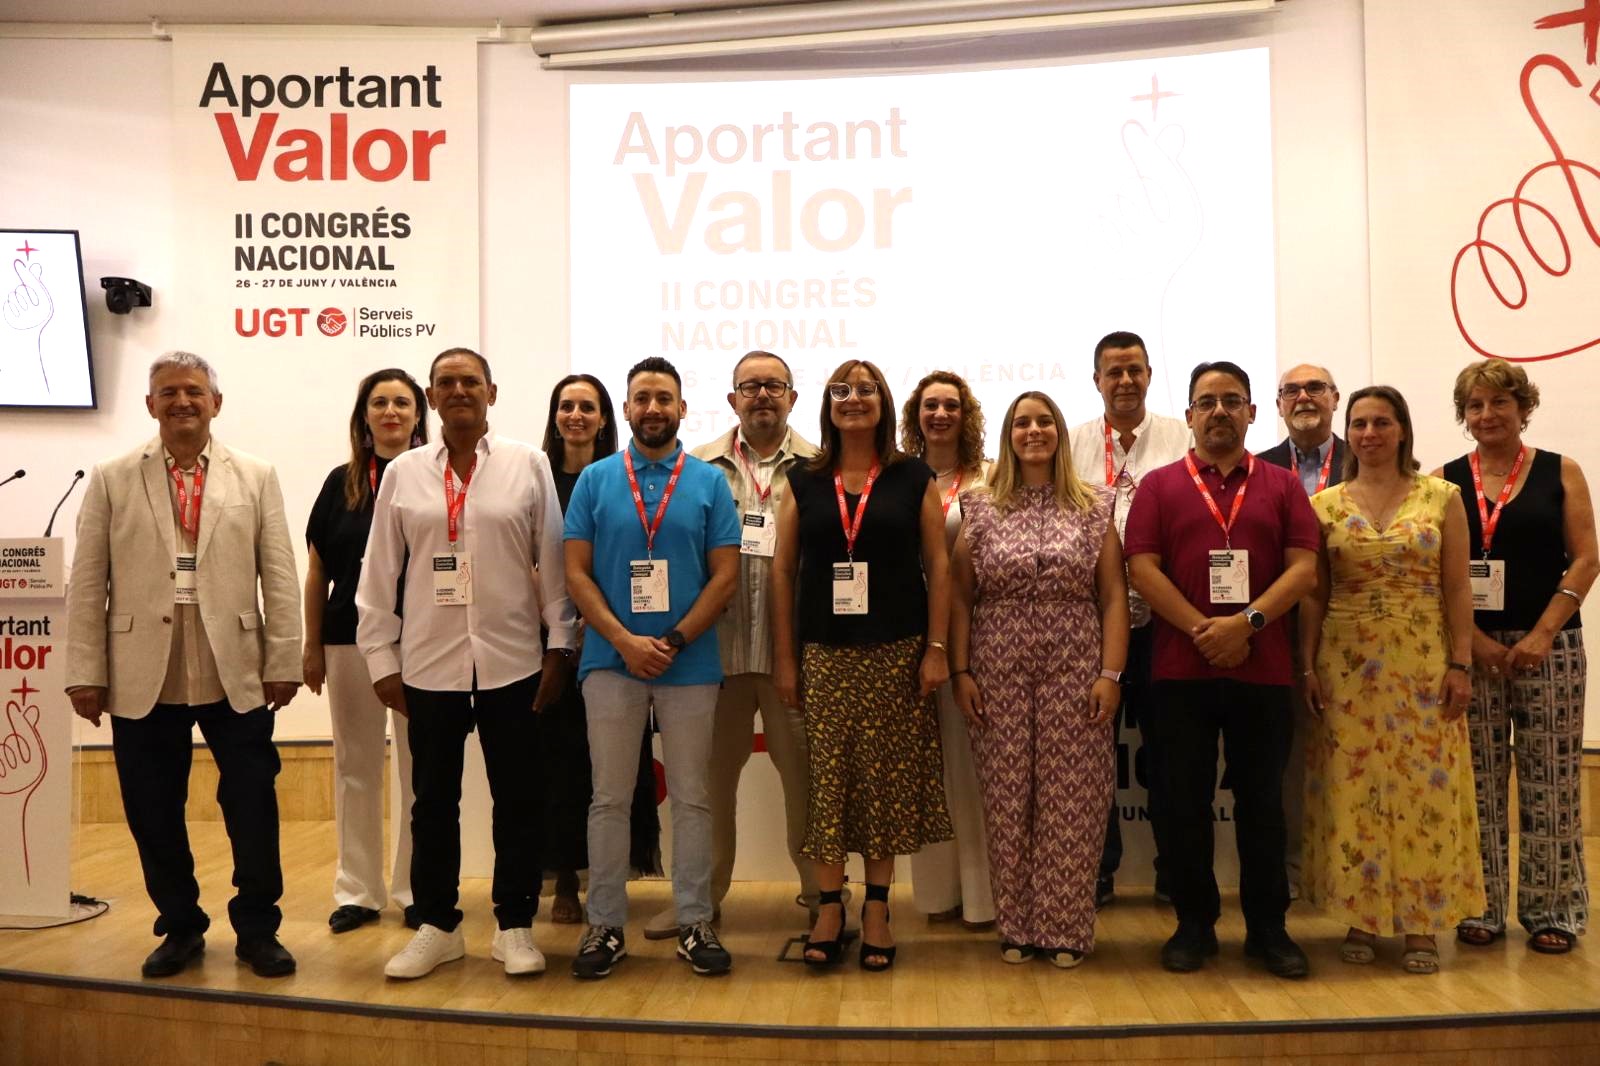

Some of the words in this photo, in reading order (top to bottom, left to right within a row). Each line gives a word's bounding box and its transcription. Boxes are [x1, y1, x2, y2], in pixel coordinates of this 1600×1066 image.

[199, 62, 442, 117] Aportant
[214, 112, 446, 182] Valor
[612, 107, 908, 177] Aportant
[235, 213, 253, 239] II
[261, 206, 412, 239] CONGRÉS
[632, 170, 913, 255] Valor
[235, 245, 395, 271] NACIONAL
[235, 279, 251, 288] 26
[262, 279, 276, 288] 27
[279, 279, 293, 288] DE
[296, 279, 328, 288] JUNY
[340, 276, 398, 288] VALÈNCIA
[661, 281, 683, 311] II
[694, 270, 877, 311] CONGRÉS
[235, 308, 310, 338] UGT
[359, 307, 413, 320] Serveis
[359, 323, 413, 338] Públics
[416, 323, 436, 337] PV
[661, 318, 858, 351] NACIONAL
[0, 558, 41, 568] ACIONAL
[3, 545, 46, 557] CONGRÉS
[0, 616, 51, 636] rtant
[0, 638, 52, 670] lor
